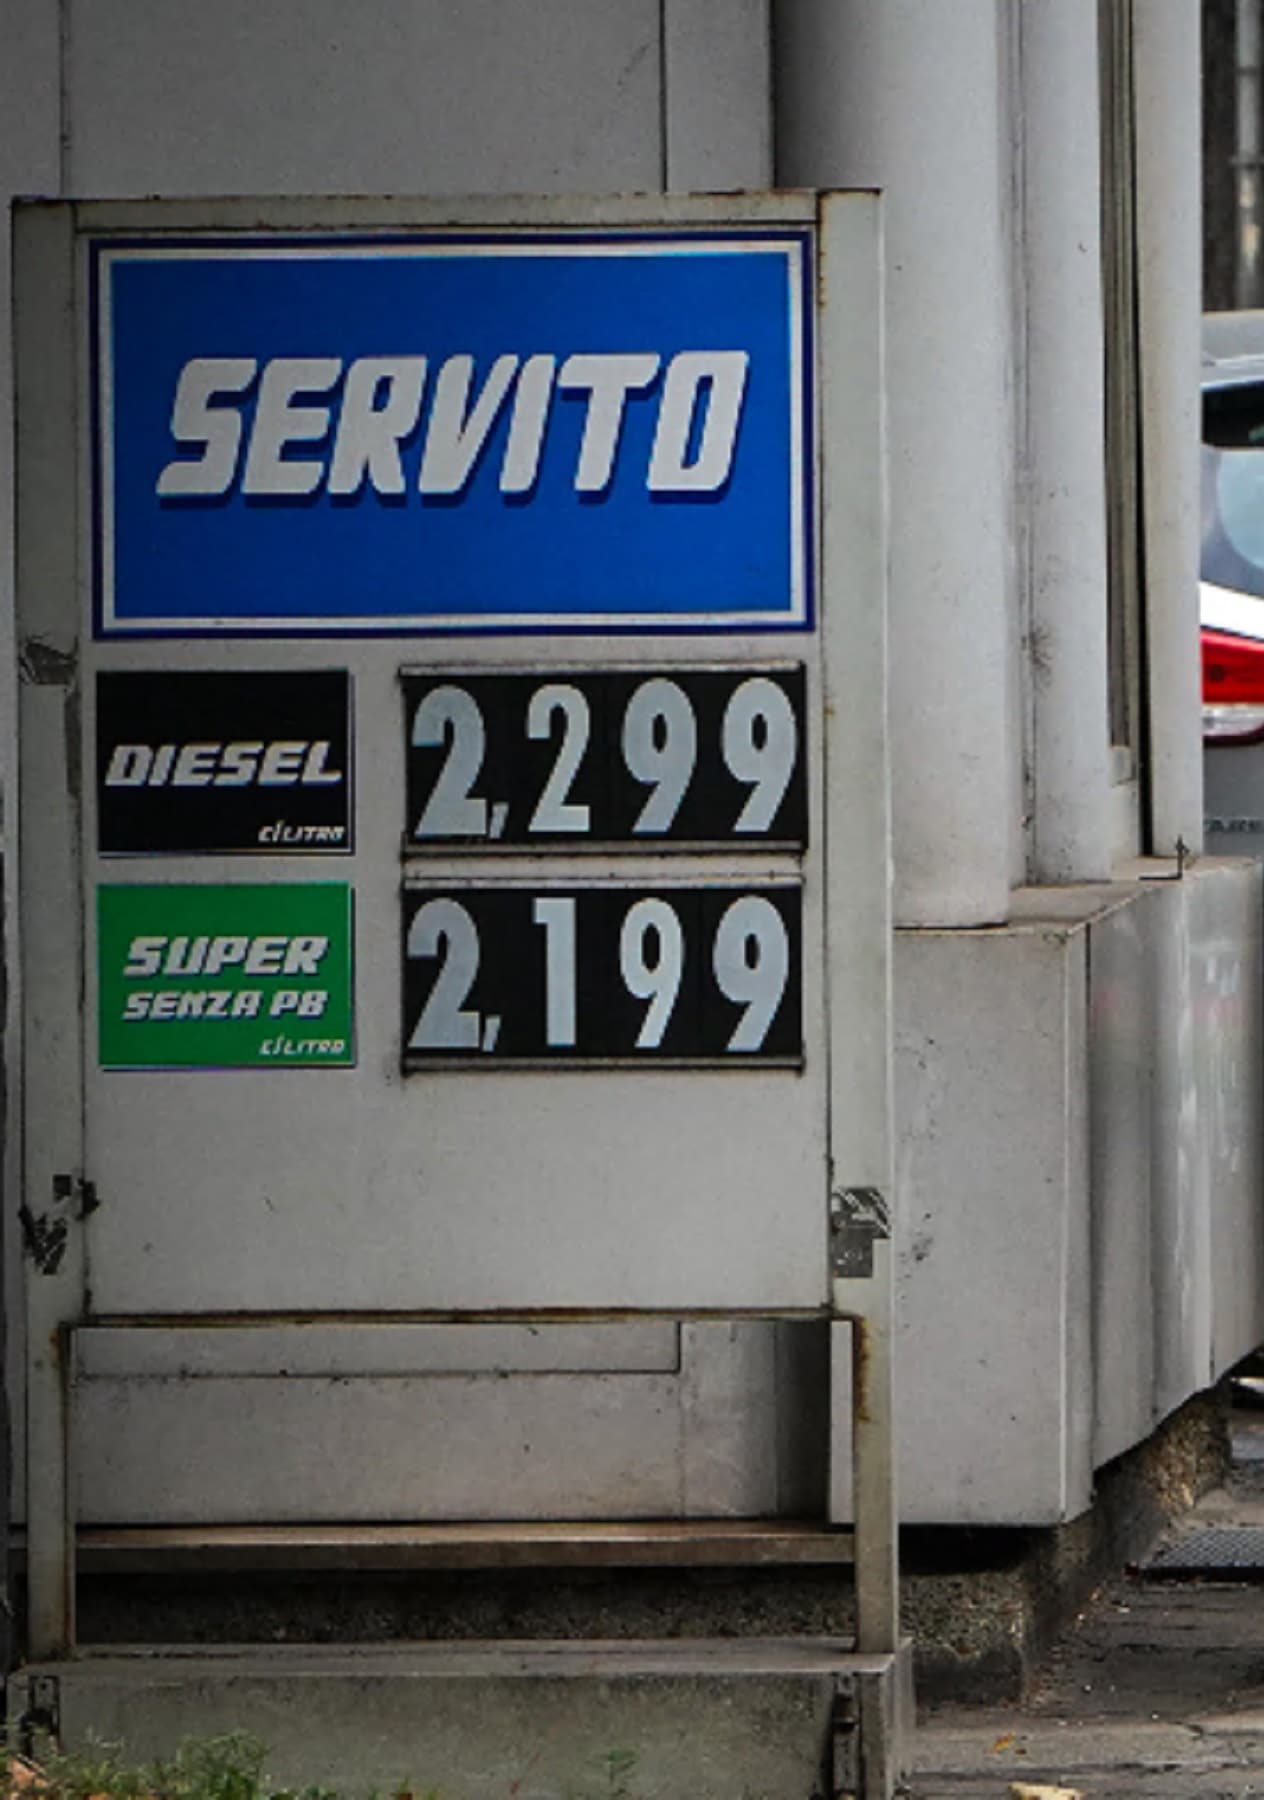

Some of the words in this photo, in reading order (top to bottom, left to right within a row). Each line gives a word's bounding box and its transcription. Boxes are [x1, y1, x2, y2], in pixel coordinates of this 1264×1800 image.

[156, 350, 750, 504] SERVITO
[104, 740, 343, 788] DIESEL
[411, 676, 800, 840] 2,299
[122, 989, 263, 1022] SENZA
[268, 989, 329, 1019] PB
[123, 935, 329, 977] SUPER
[406, 895, 790, 1052] 2,199
